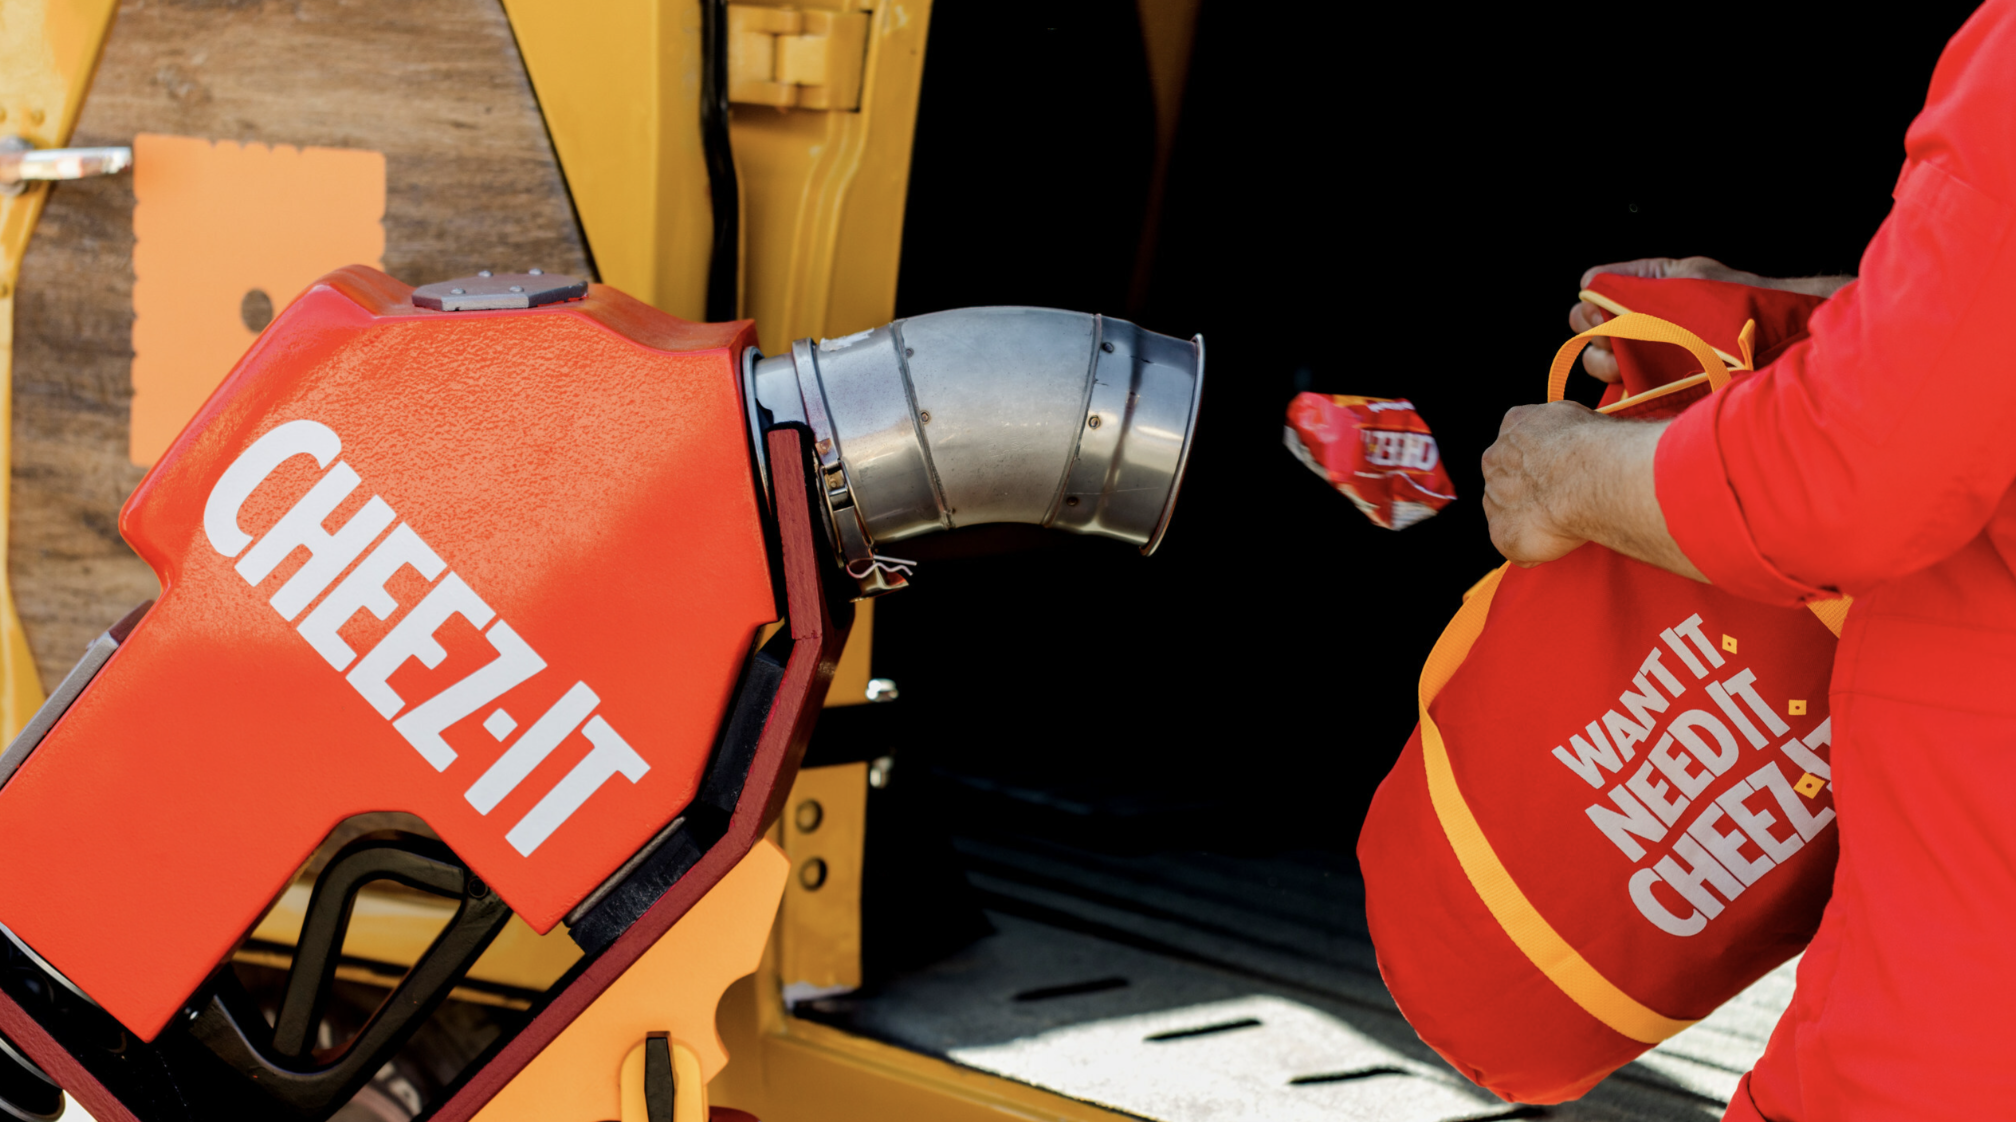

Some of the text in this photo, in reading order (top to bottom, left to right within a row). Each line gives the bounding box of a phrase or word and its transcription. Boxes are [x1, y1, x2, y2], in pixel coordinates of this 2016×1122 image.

[204, 419, 651, 858] CHEEZ-IT
[1551, 646, 1686, 789] WANT
[1585, 709, 1739, 863] NEED
